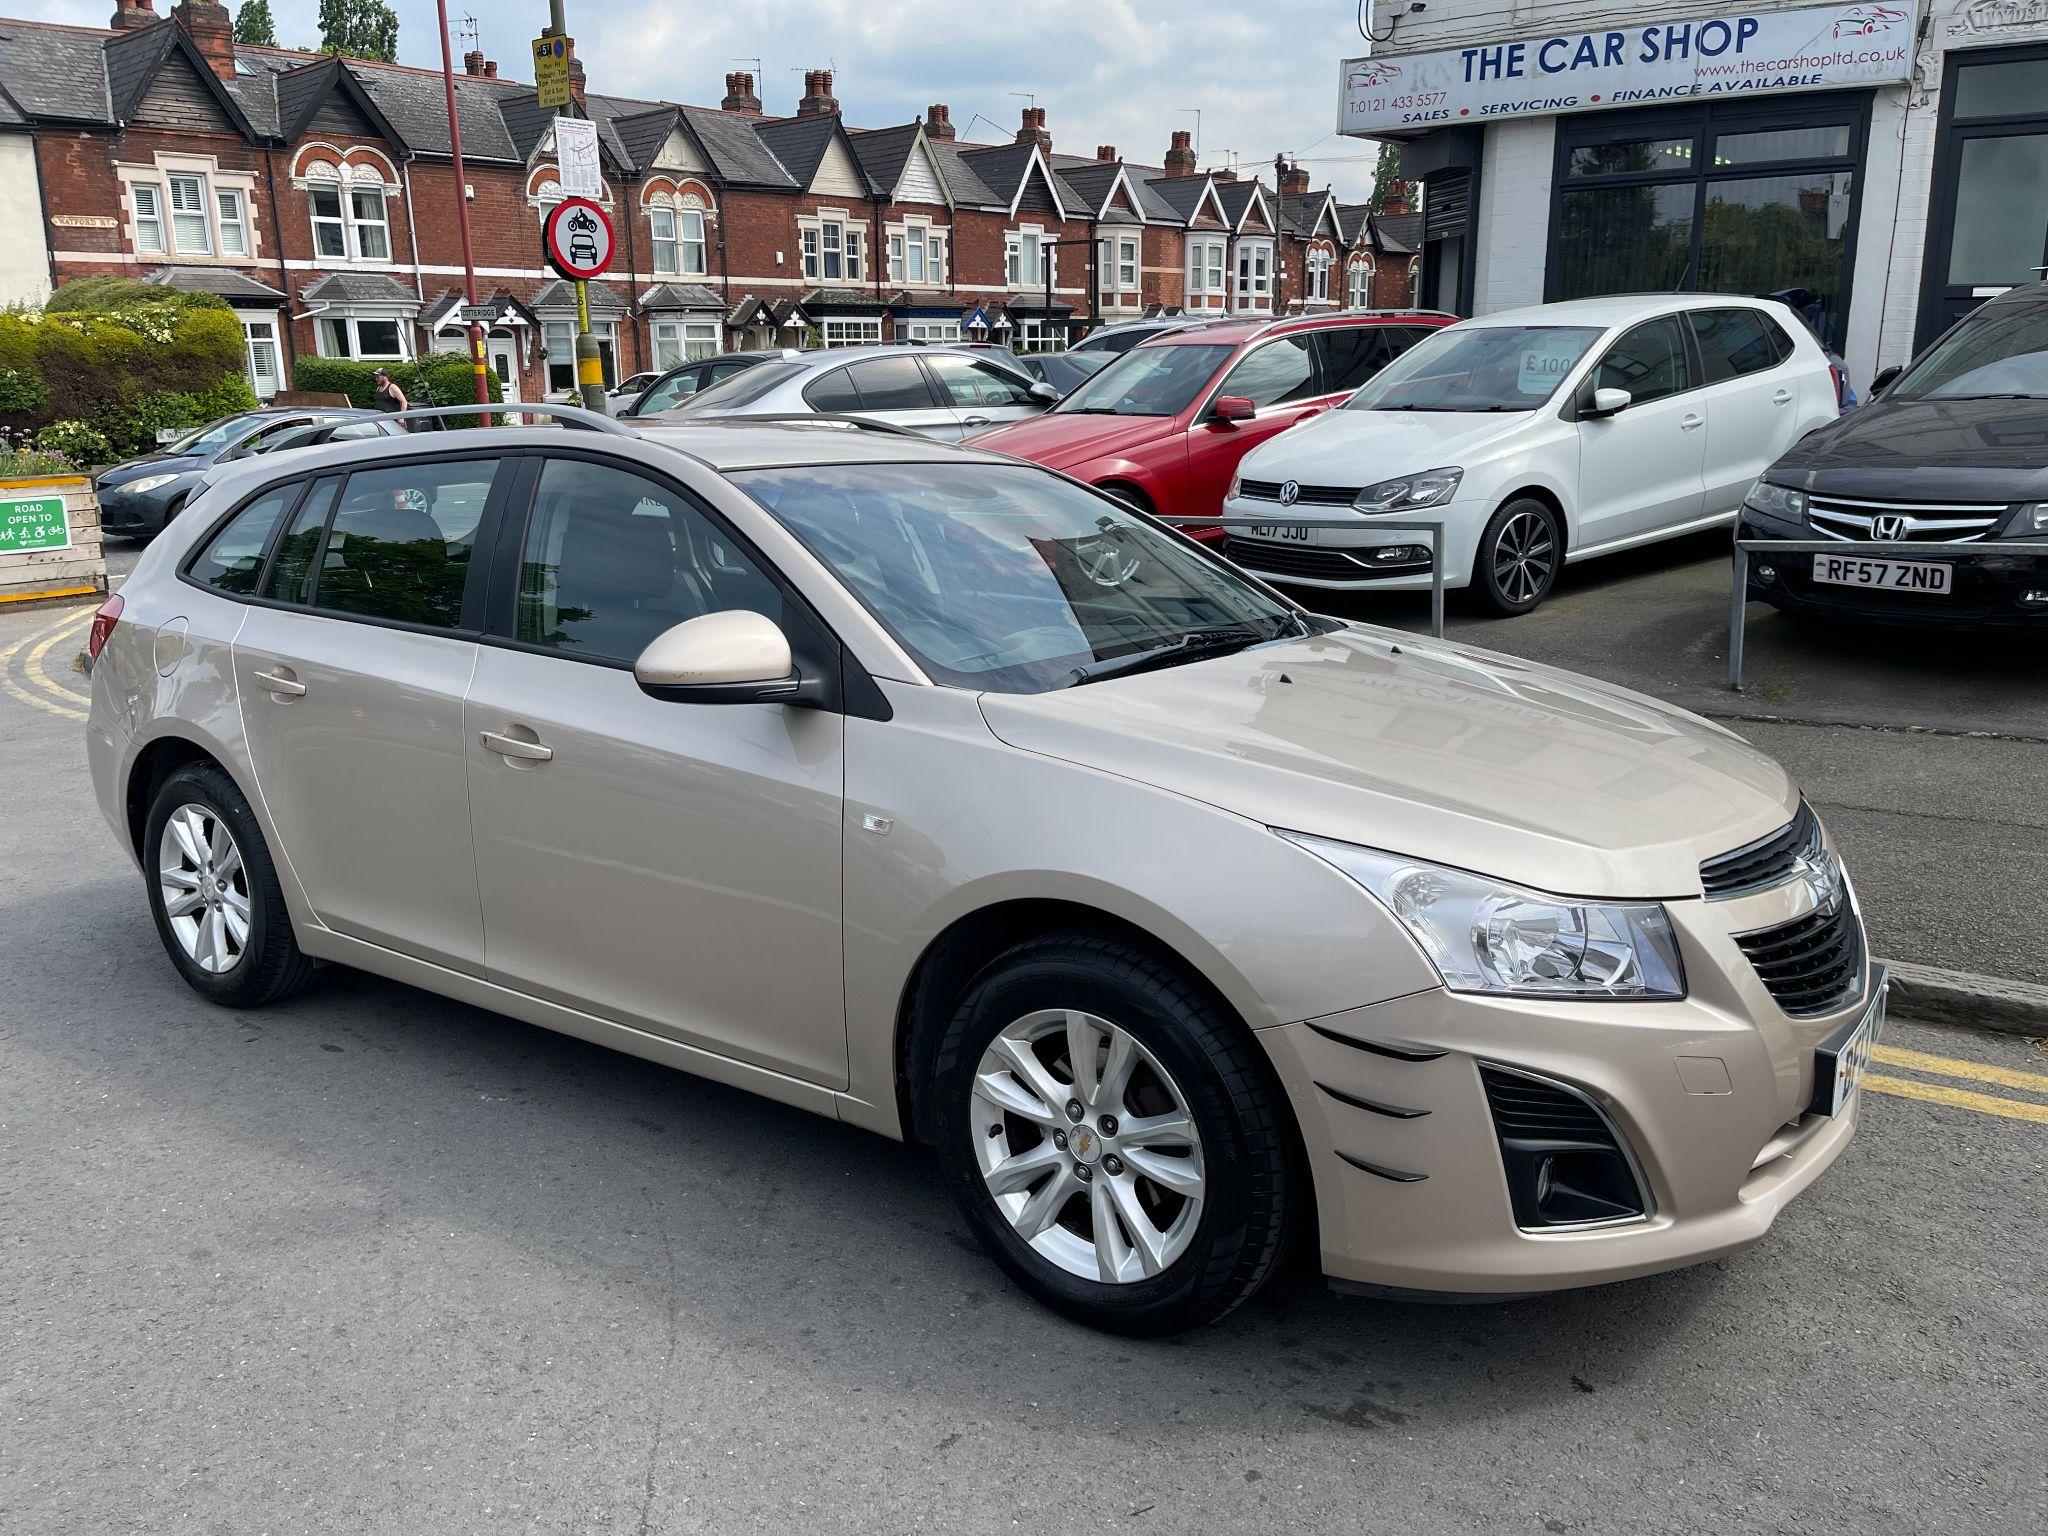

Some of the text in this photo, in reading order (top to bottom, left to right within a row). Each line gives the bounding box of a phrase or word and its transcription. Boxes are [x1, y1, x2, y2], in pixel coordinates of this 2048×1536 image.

[1462, 43, 1525, 83] THE
[1539, 32, 1624, 73] CAR
[1639, 18, 1758, 63] SHOP
[1694, 46, 1905, 77] www.thecarshopltd.co.uk
[1391, 96, 1413, 109] 433
[1417, 92, 1447, 107] 5577
[1402, 74, 1822, 123] SALES SERVICING FINANCE AVAILABLE
[8, 513, 53, 525] OPEN TO
[14, 504, 43, 514] ROAD
[1827, 559, 1945, 590] RF57 ZND
